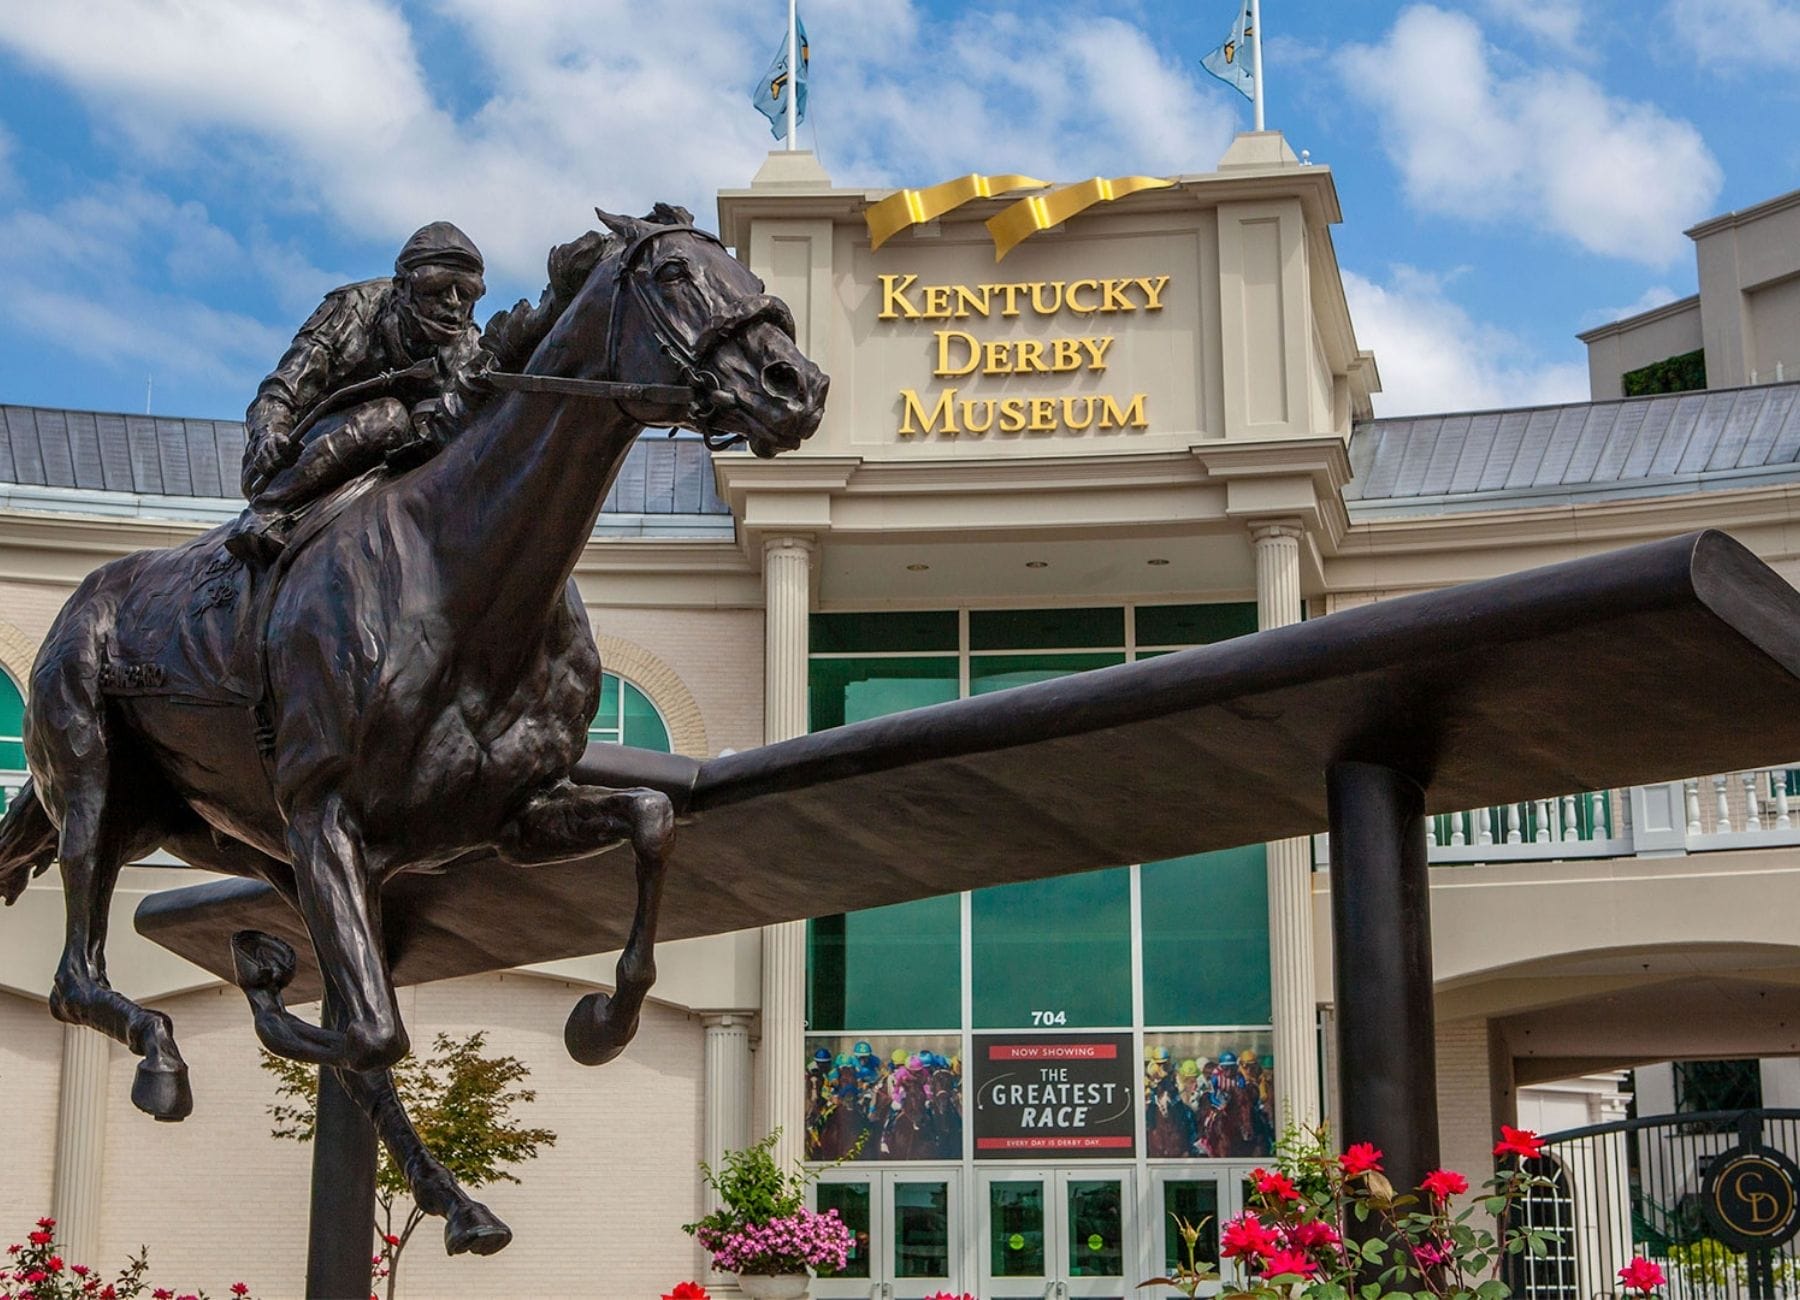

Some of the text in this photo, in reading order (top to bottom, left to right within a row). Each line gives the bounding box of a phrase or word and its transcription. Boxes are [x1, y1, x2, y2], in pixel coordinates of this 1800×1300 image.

[878, 274, 1170, 319] KENTUCKY
[933, 330, 1114, 376] DERBY
[898, 388, 1149, 434] MUSEUM
[1031, 1011, 1067, 1025] 704
[1011, 1047, 1095, 1057] NOW SHOWING
[1040, 1068, 1068, 1082] THE
[992, 1083, 1117, 1105] GREATEST
[1021, 1106, 1089, 1128] RACE
[1006, 1140, 1028, 1148] EVERY
